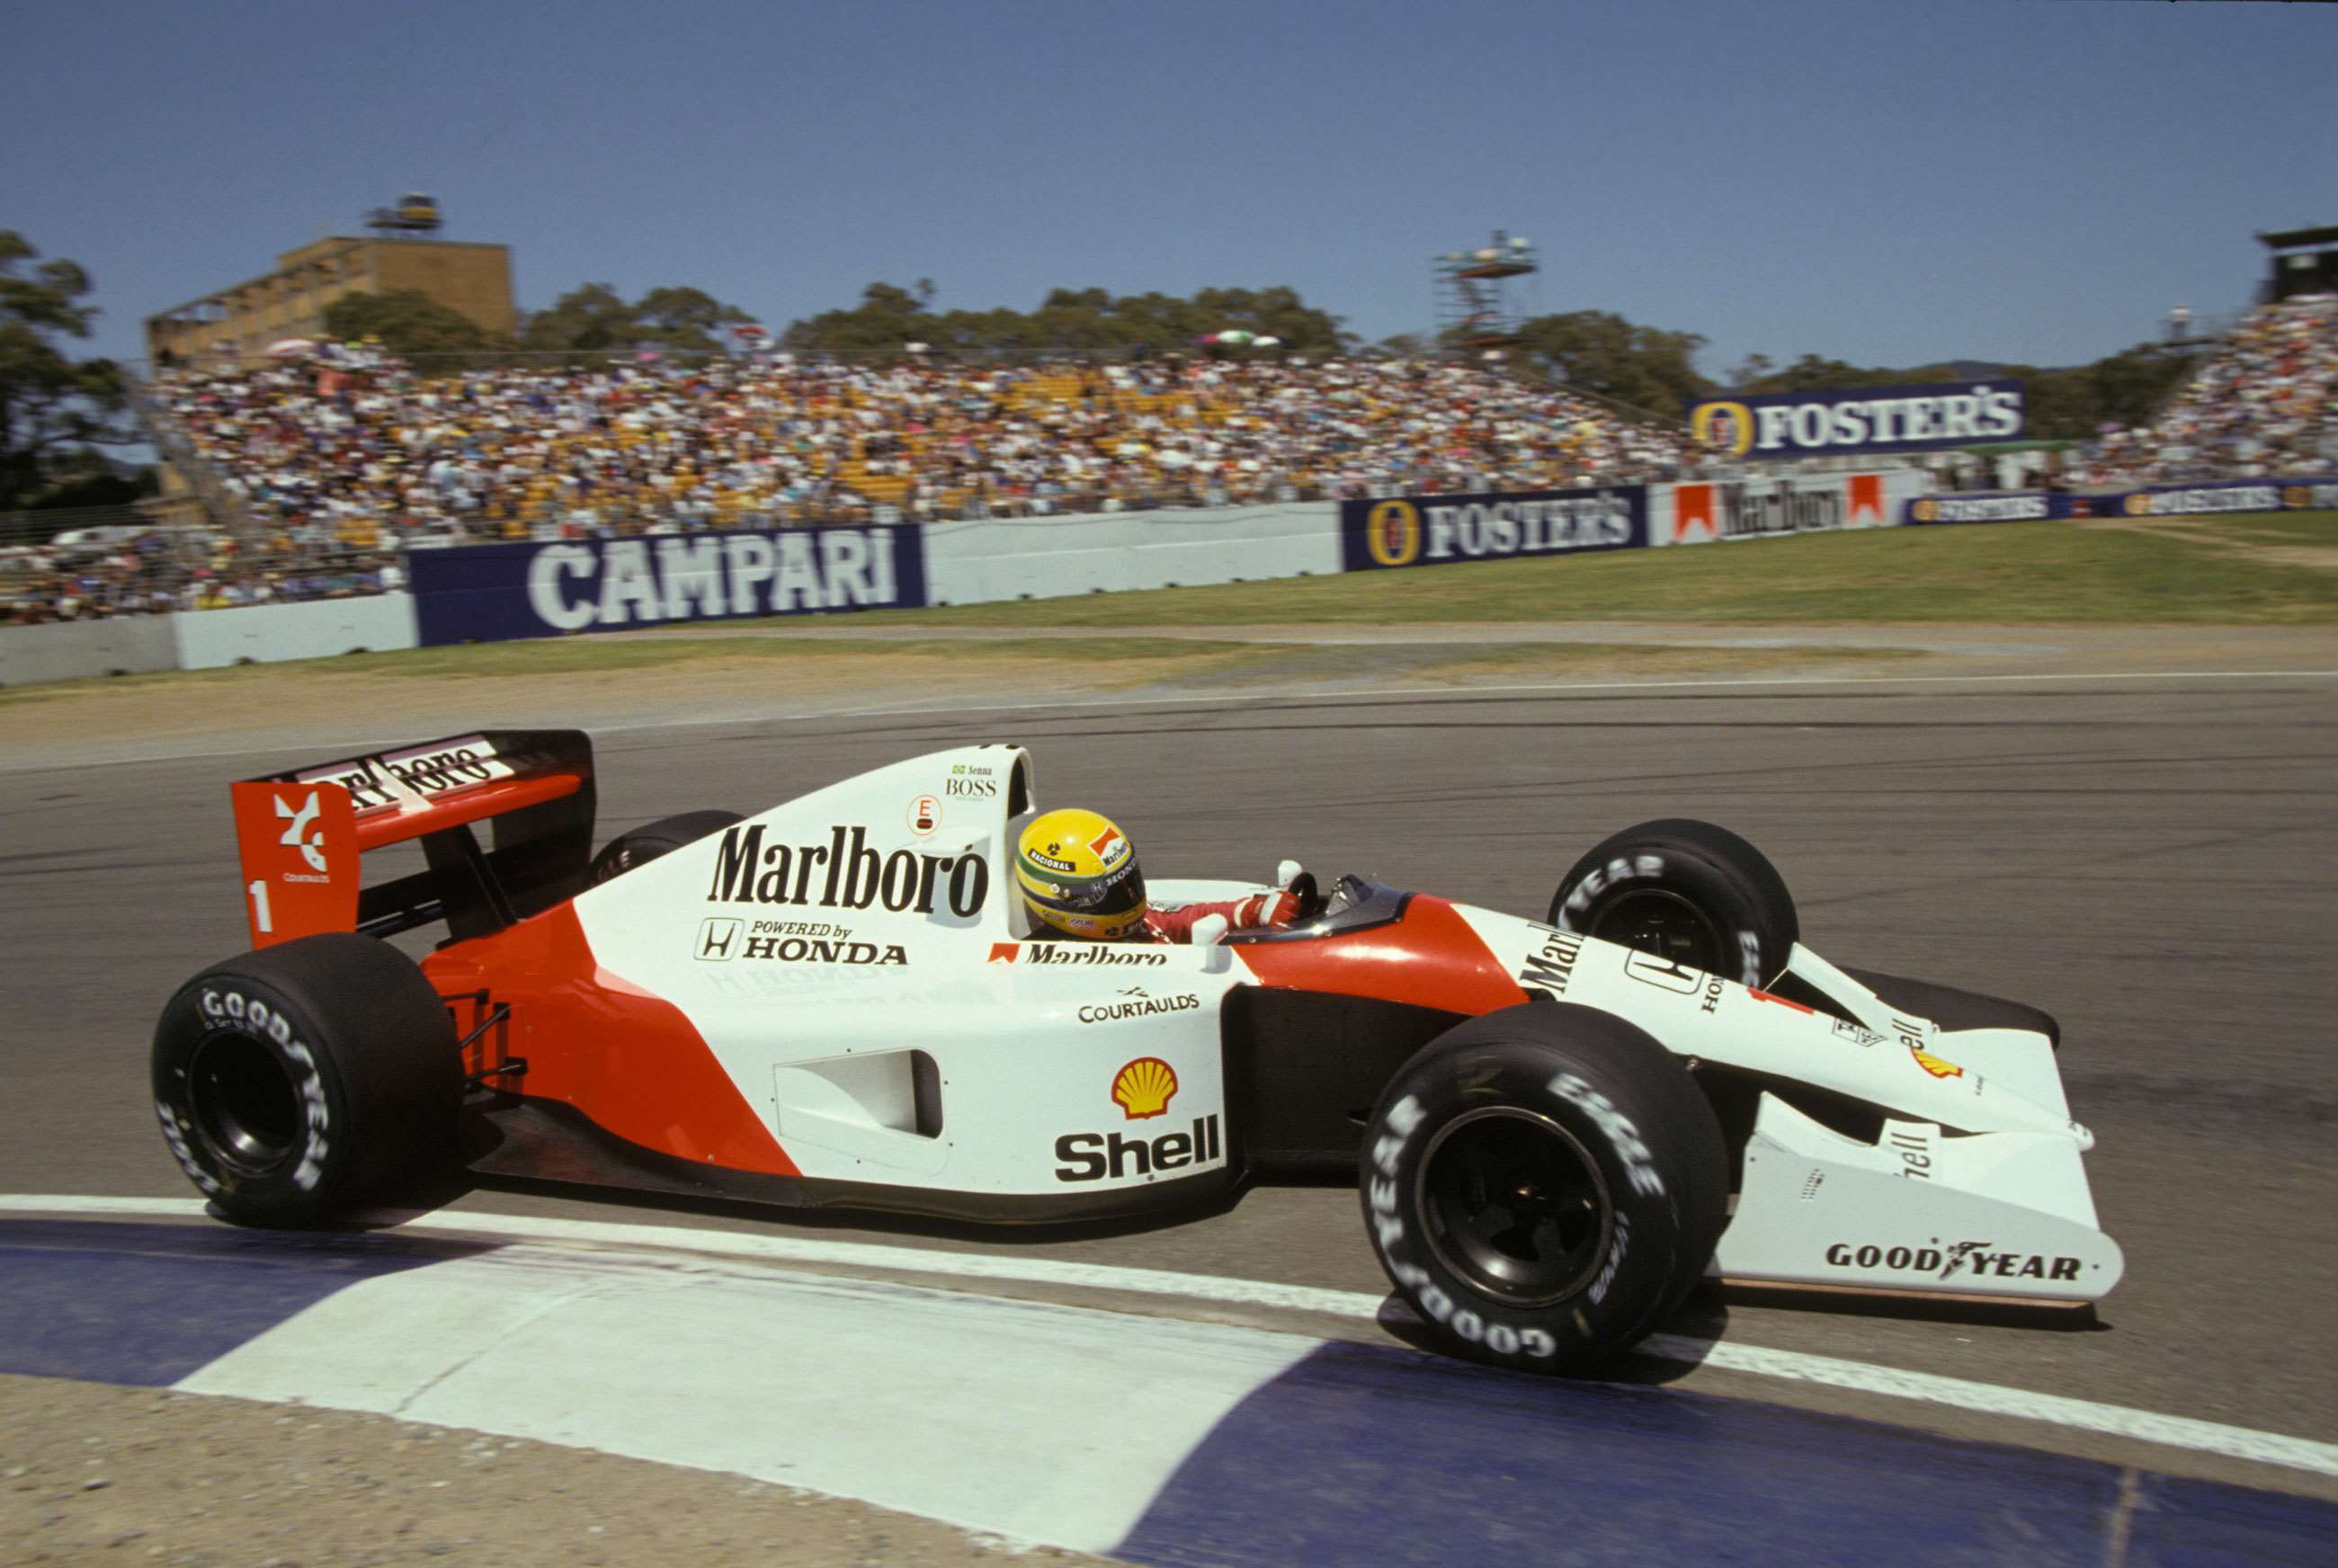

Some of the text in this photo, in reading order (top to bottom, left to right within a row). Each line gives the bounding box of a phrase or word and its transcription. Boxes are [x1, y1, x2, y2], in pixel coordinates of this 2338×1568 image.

[1754, 386, 2022, 448] FOSTER'S
[1424, 491, 1632, 557] FOSTER'S
[528, 529, 896, 630] CAMPARI
[968, 765, 993, 776] Senna
[946, 778, 997, 797] BOSS
[920, 800, 932, 816] E
[707, 824, 989, 918] Marlboro
[1031, 851, 1071, 870] NACIONAL
[249, 879, 273, 933] 1
[752, 922, 852, 940] POWERED by
[743, 937, 909, 965] HONDA
[1027, 944, 1167, 966] Marlboro
[1079, 993, 1200, 1023] COURTAULDS
[1055, 1113, 1220, 1182] Shell
